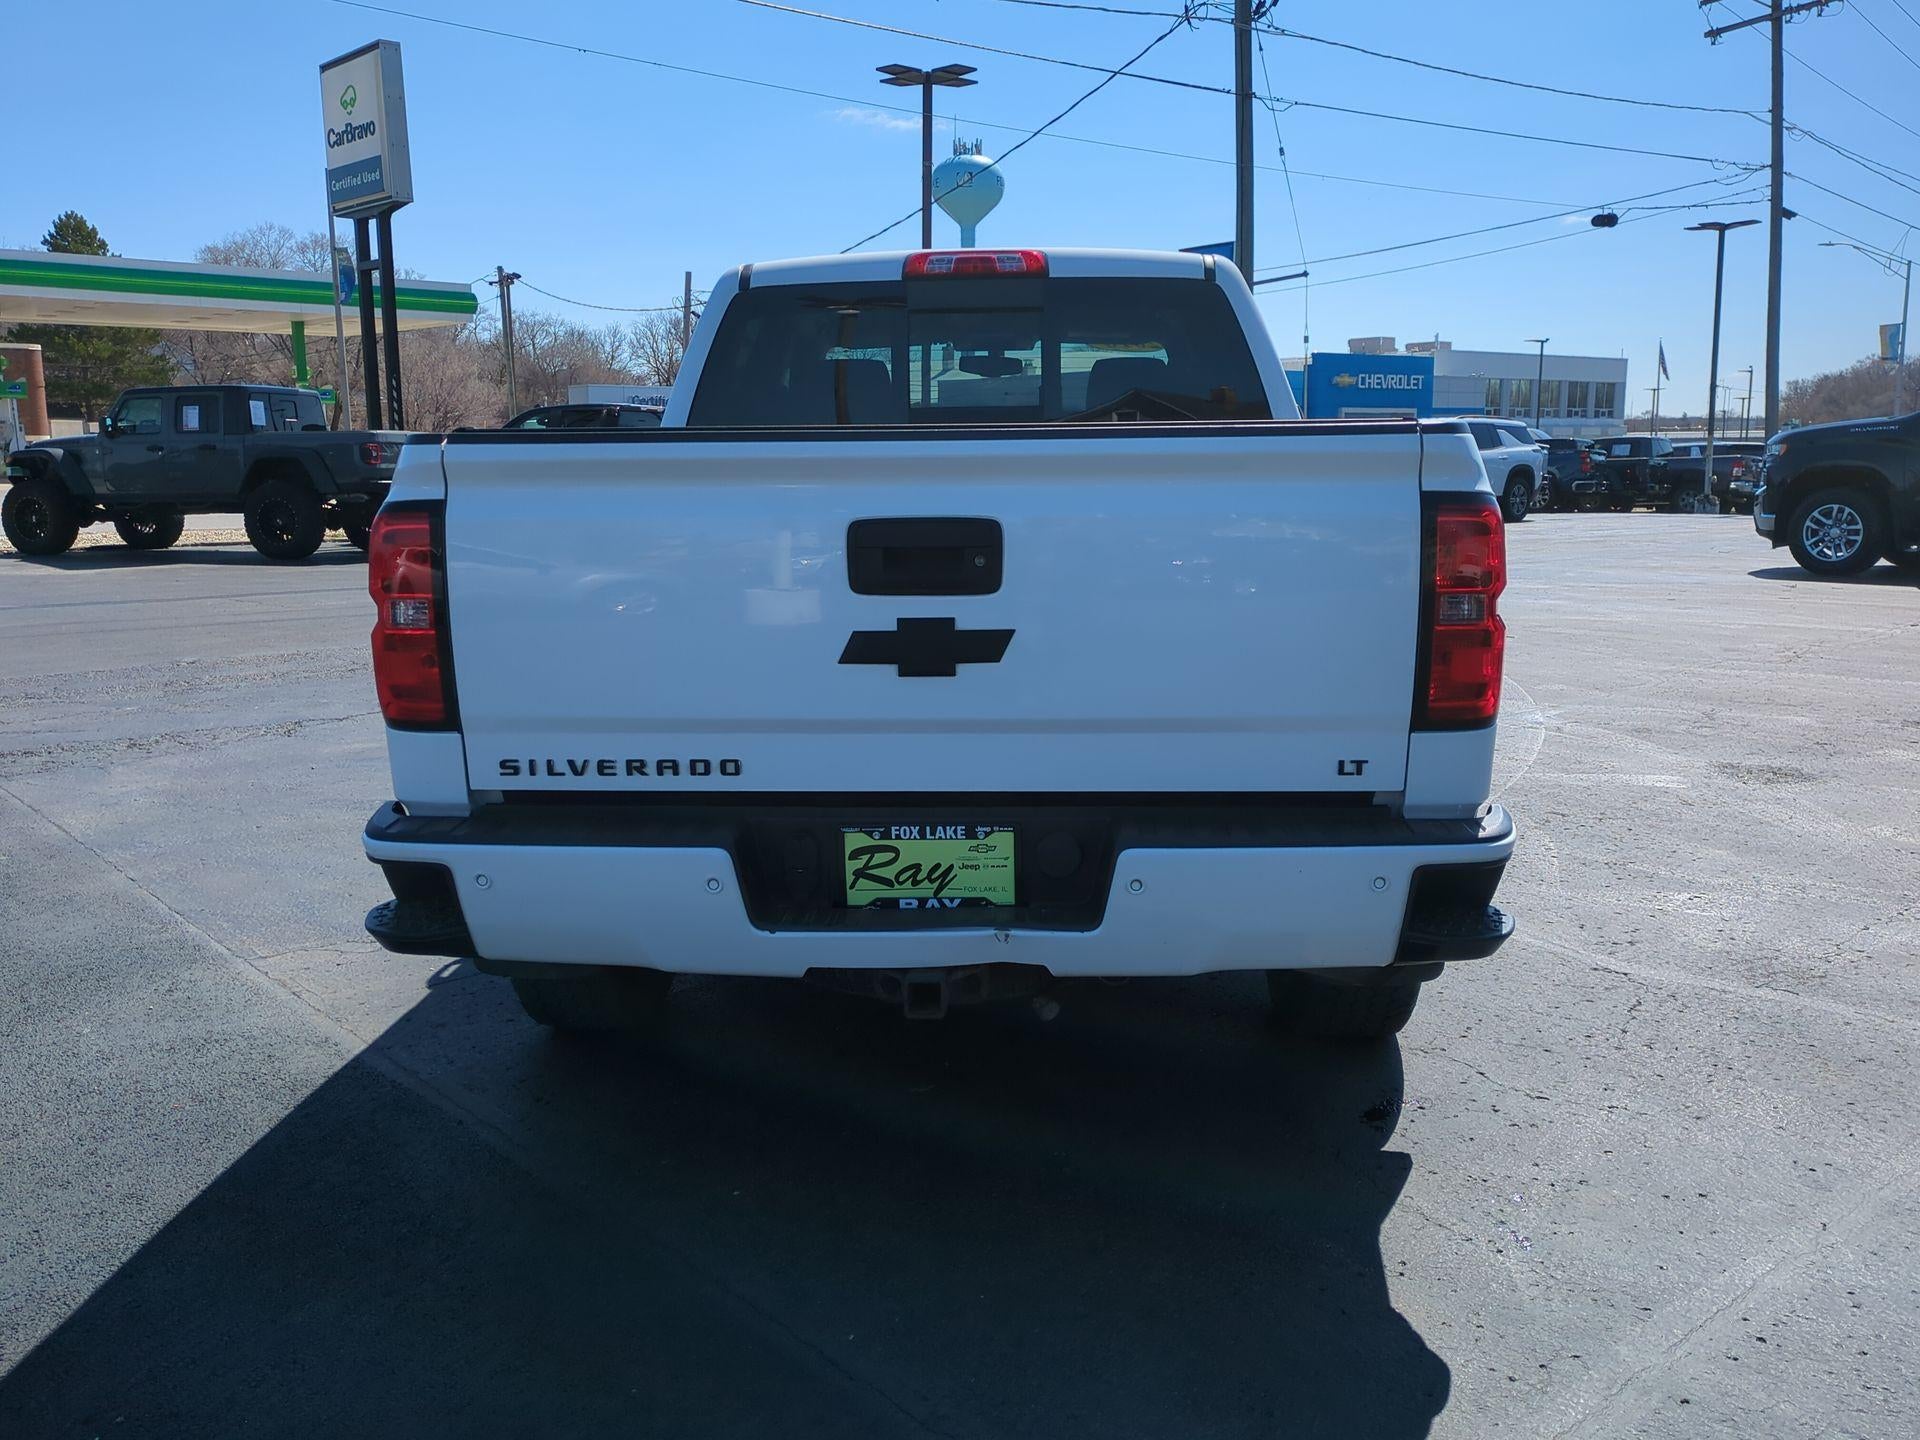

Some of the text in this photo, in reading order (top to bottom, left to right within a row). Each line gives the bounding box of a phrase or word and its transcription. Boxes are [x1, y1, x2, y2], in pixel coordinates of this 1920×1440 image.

[327, 120, 376, 149] CarBravo
[331, 169, 380, 191] Certified Used
[1358, 374, 1424, 389] CHEVROLET
[499, 759, 743, 776] SILVERADO
[1338, 760, 1369, 776] LT
[891, 825, 966, 839] FOX LAKE
[848, 844, 958, 897] Ray
[958, 862, 980, 871] Jeep
